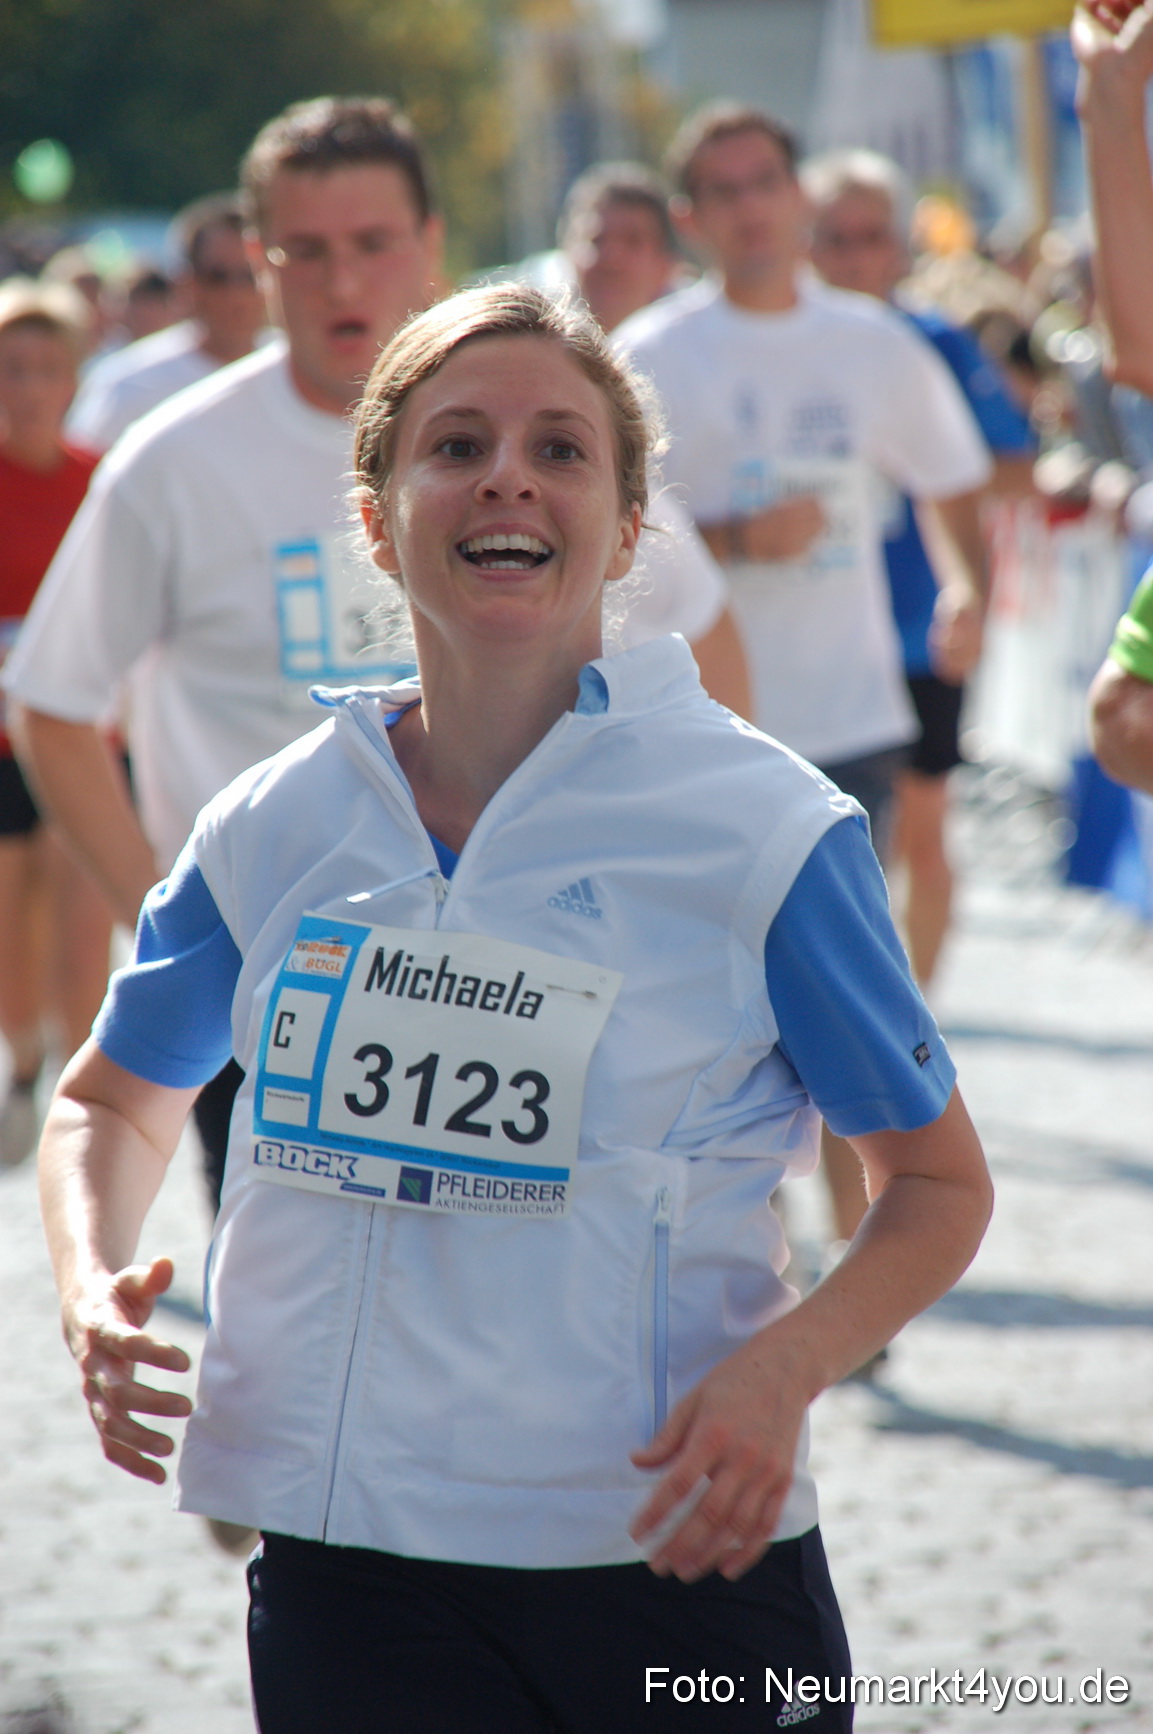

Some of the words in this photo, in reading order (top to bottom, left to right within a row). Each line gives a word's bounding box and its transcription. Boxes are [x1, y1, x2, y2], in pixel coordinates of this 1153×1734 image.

[546, 896, 603, 919] adidas
[364, 946, 545, 1020] Michaela
[273, 1010, 296, 1049] C
[343, 1042, 551, 1146] 3123
[253, 1140, 359, 1181] BOCK
[436, 1172, 566, 1202] PFLEIDERER
[435, 1198, 566, 1215] AKTIENGESELLSCHAFT
[776, 1702, 820, 1728] adidas
